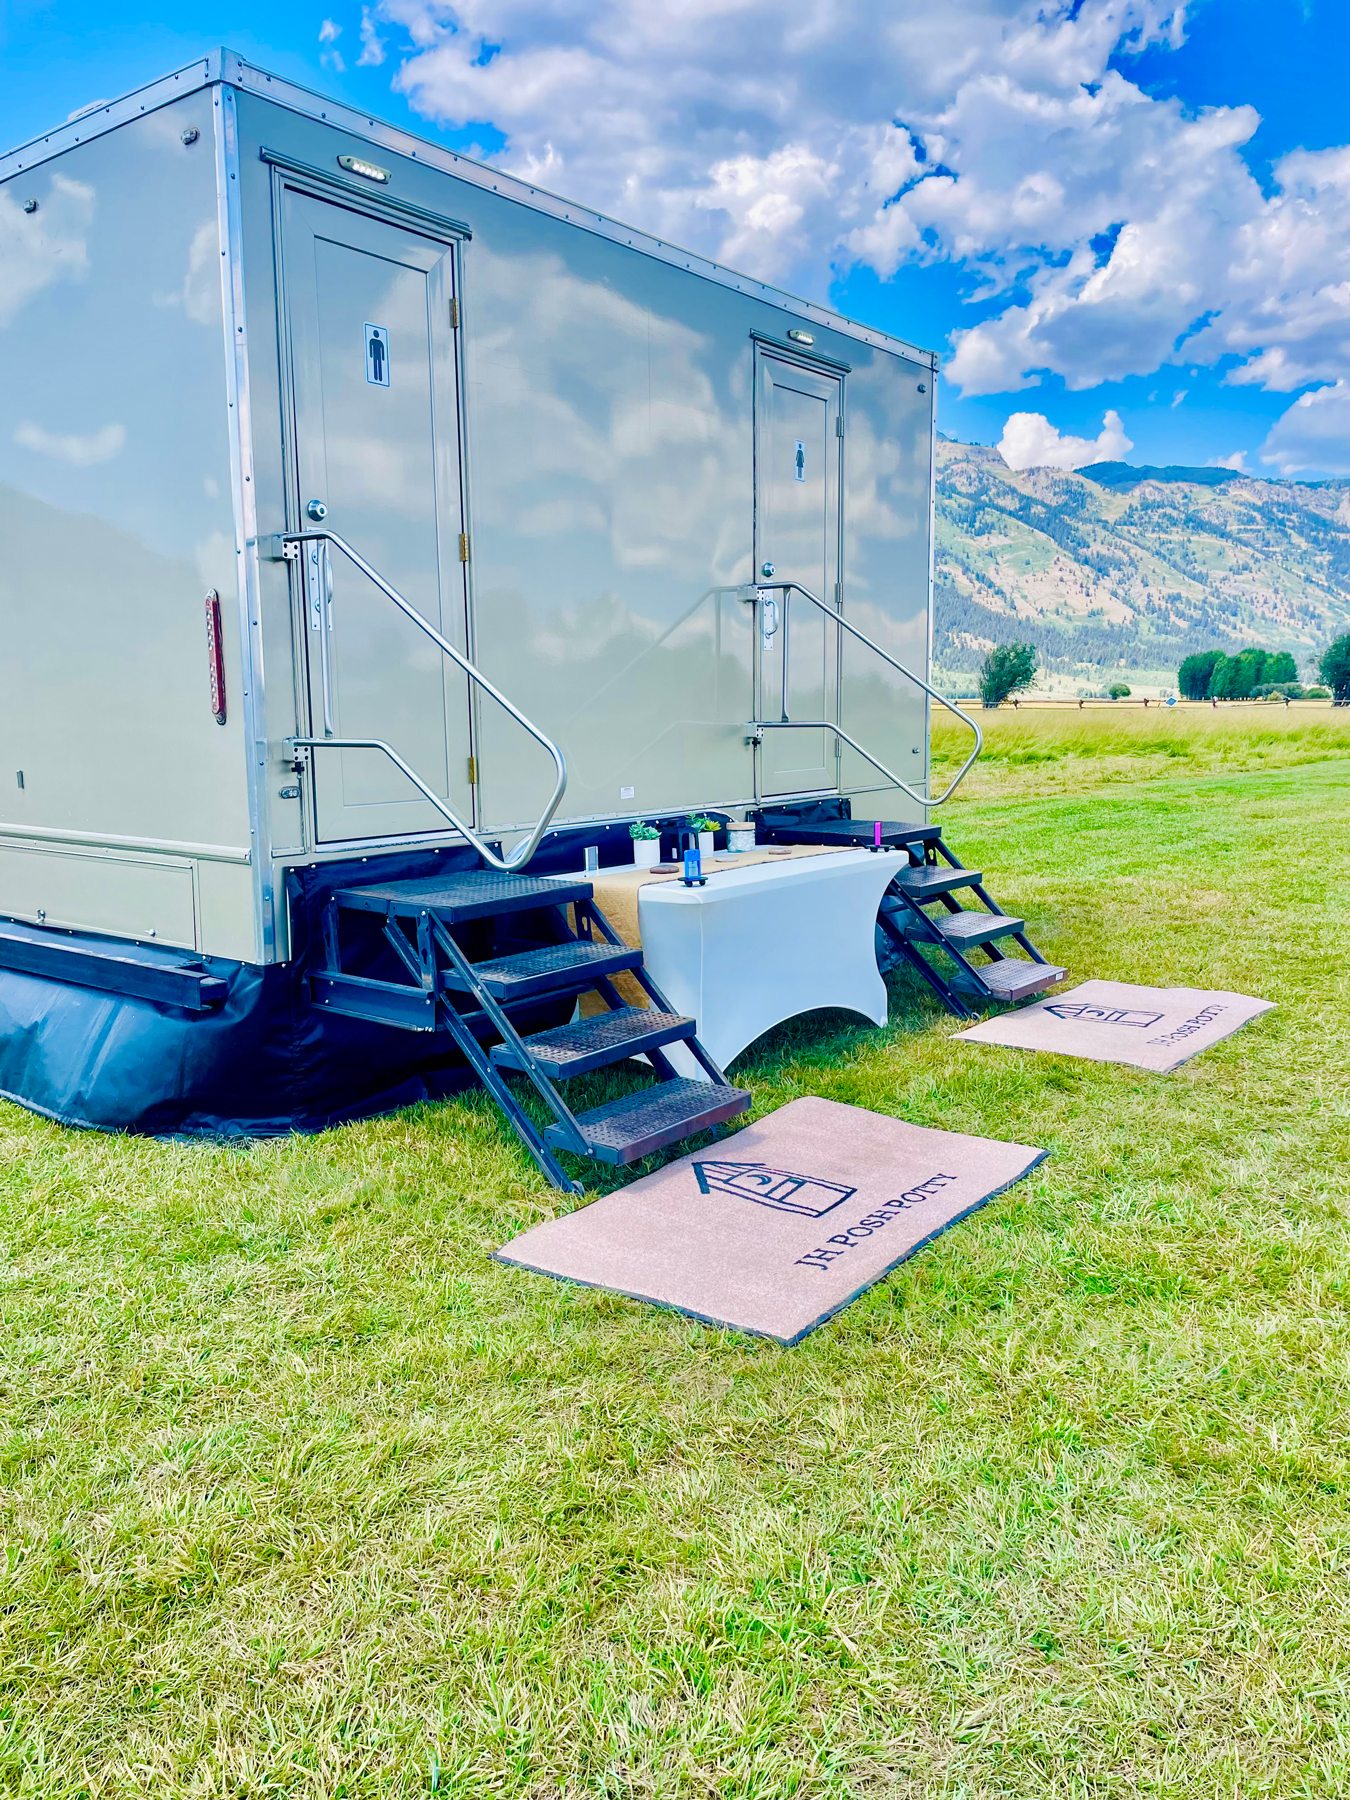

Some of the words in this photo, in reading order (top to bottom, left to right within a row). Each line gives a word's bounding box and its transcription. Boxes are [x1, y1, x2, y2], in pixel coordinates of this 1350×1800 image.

[1160, 1024, 1201, 1041] POSH
[1186, 1004, 1229, 1026] POTTY
[793, 1248, 844, 1270] JH
[826, 1209, 901, 1247] POSH
[882, 1173, 958, 1209] POTTY
